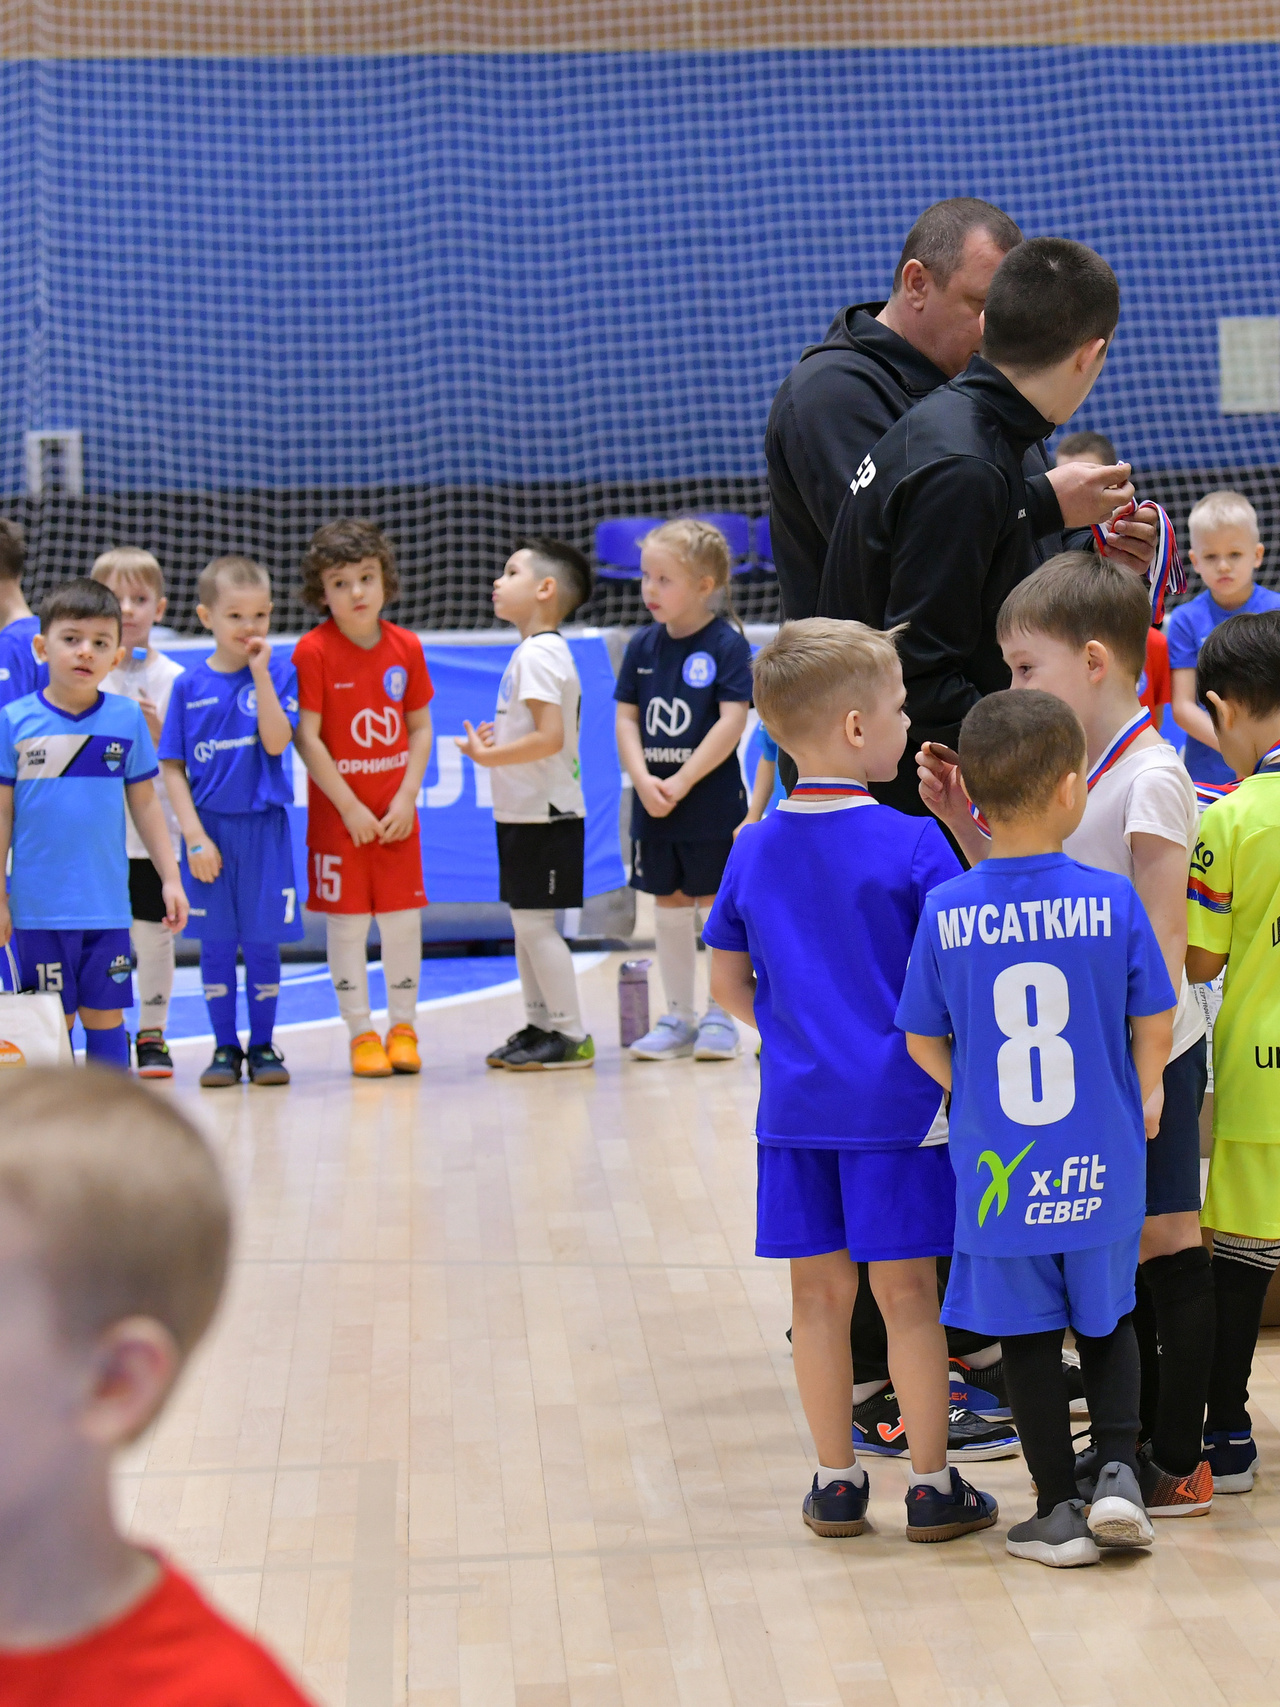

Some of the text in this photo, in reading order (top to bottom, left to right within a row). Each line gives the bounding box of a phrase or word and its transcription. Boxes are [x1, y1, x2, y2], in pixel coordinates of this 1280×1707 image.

[937, 897, 1112, 950] МУСАТКИН
[36, 962, 64, 991] 15
[993, 961, 1076, 1126] 8
[1024, 1196, 1103, 1226] СЕВЕР
[949, 1391, 968, 1401] EX
